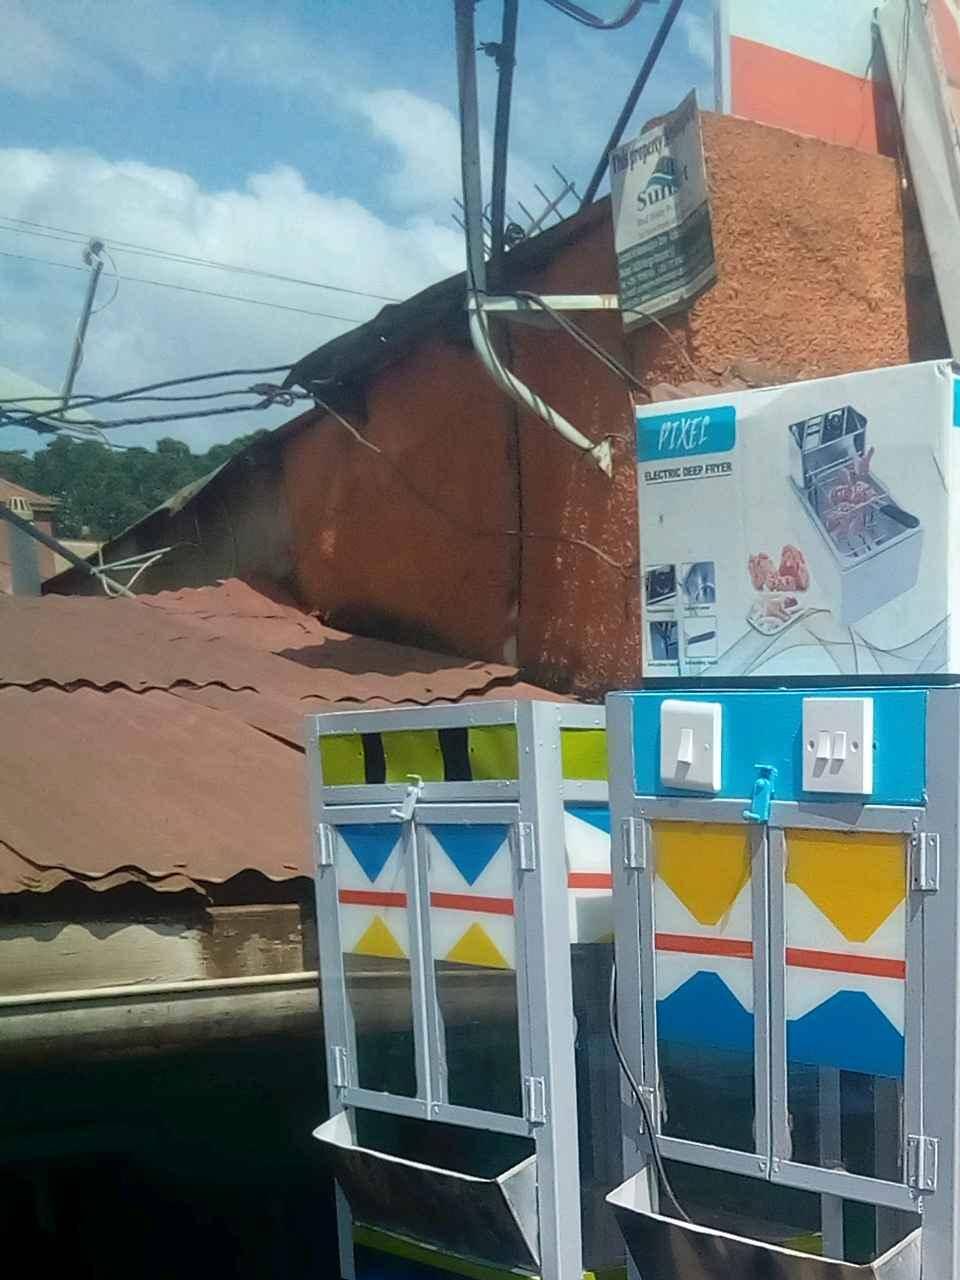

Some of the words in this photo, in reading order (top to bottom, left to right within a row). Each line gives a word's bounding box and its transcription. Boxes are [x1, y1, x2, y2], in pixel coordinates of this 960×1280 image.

[644, 467, 681, 482] ELECTRIC
[682, 464, 704, 478] DEEP
[705, 461, 733, 475] FRYER
